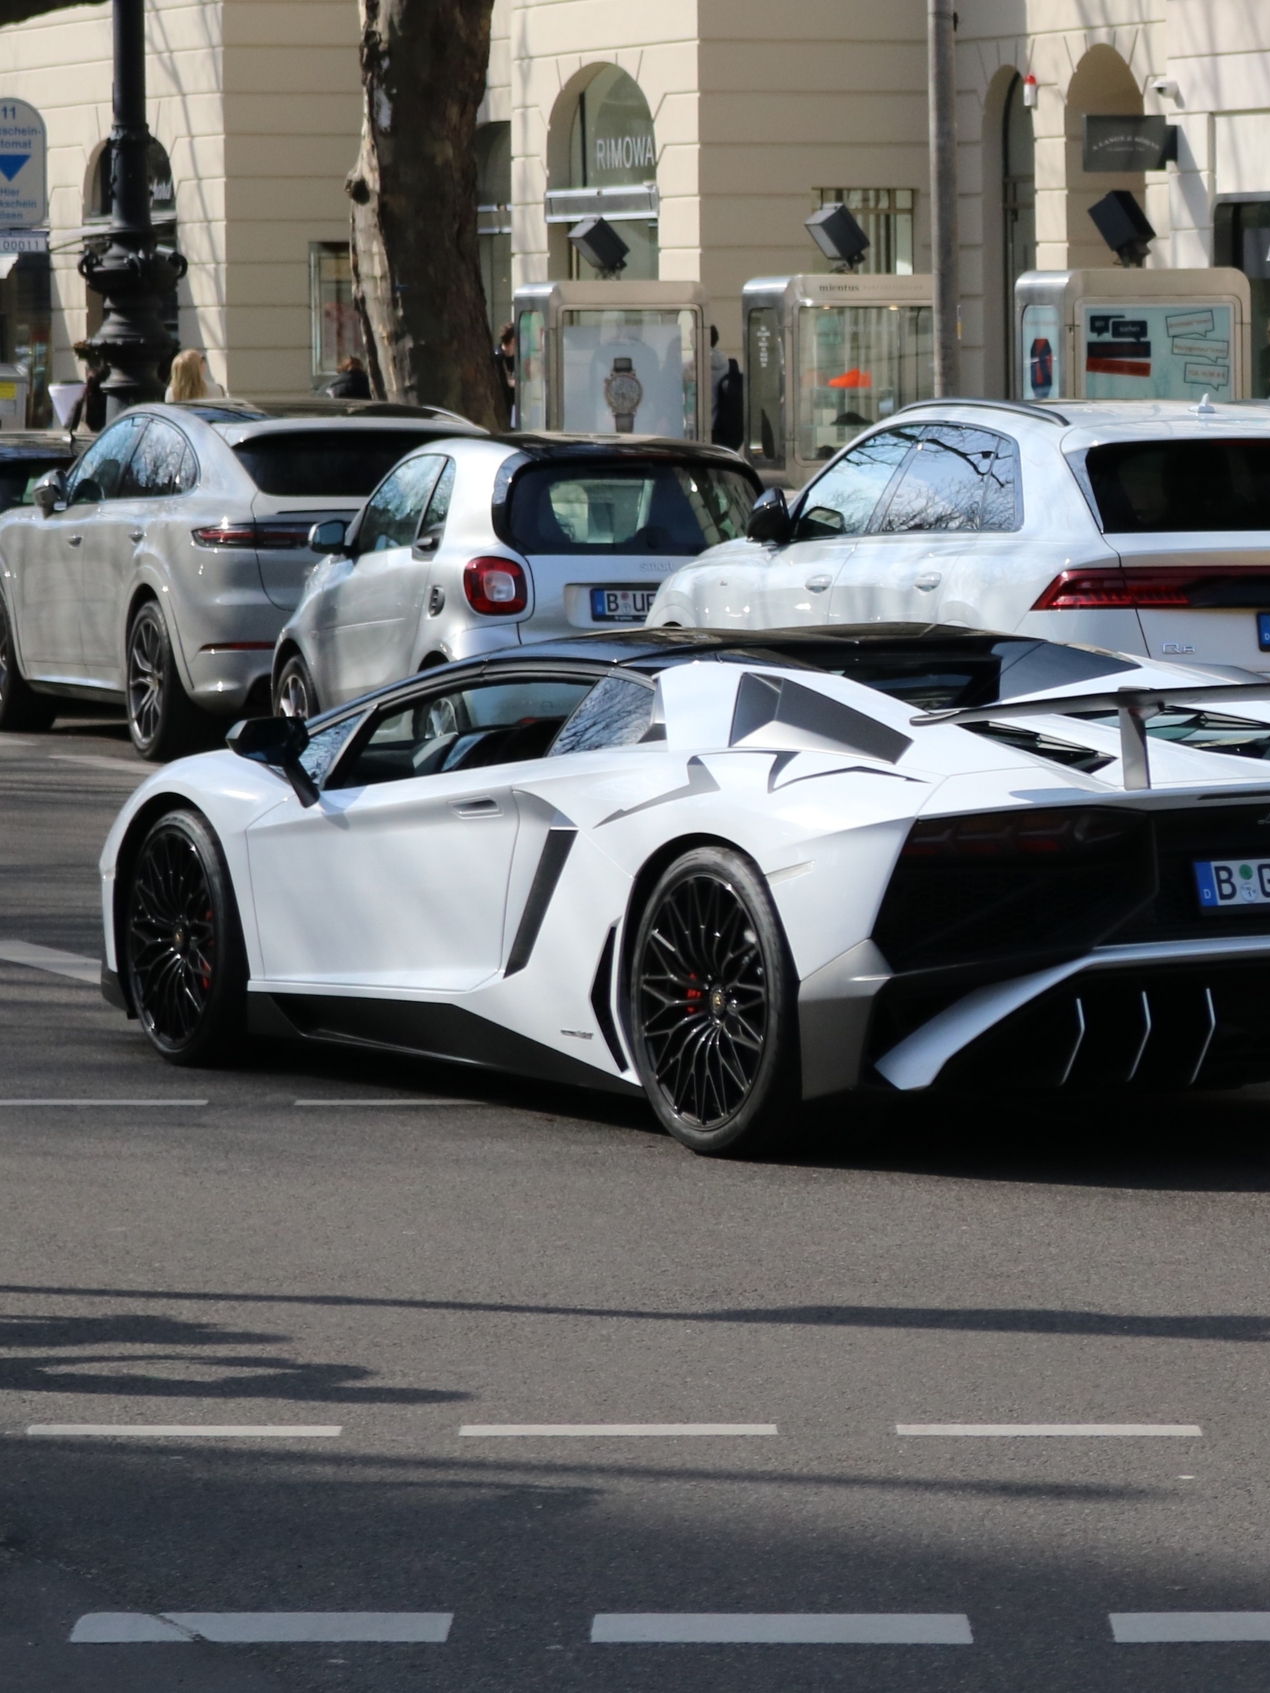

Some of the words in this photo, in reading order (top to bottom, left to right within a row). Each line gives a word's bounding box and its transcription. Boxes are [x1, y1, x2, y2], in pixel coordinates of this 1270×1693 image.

[596, 136, 655, 171] RIMOWA
[819, 284, 860, 292] mientus
[606, 593, 619, 612] B
[1264, 633, 1270, 641] D
[1203, 889, 1212, 899] D
[1213, 865, 1238, 901] B
